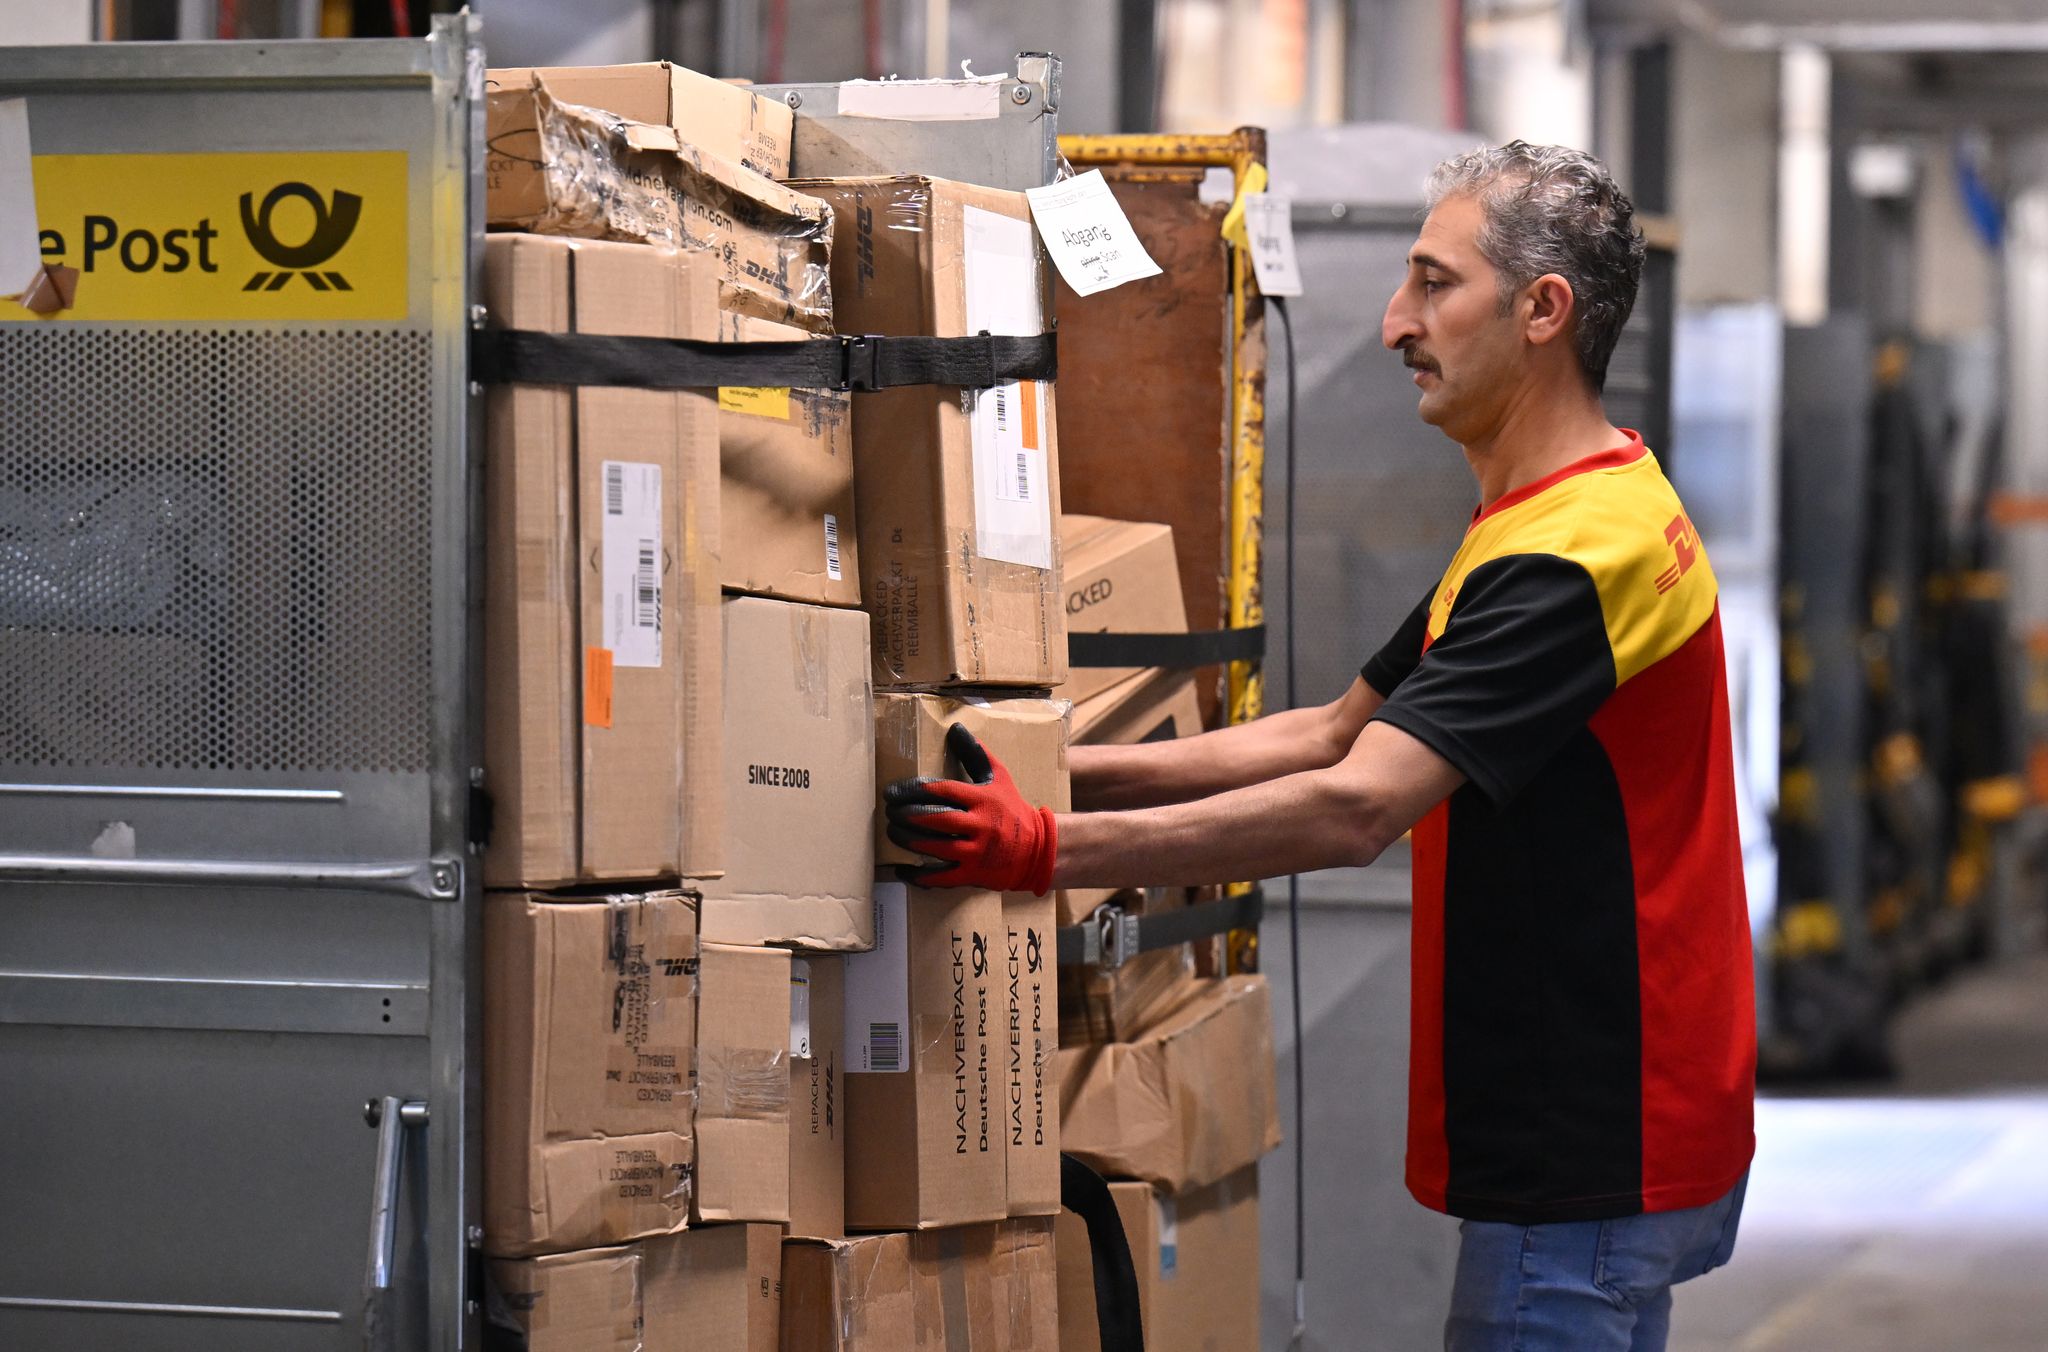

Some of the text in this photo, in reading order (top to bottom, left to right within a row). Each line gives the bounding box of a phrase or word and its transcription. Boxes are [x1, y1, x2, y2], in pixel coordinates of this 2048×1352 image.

[83, 215, 218, 274] Post
[856, 198, 873, 292] DHL
[1061, 223, 1112, 248] Abgang
[876, 581, 889, 654] REPACKED
[749, 764, 810, 789] SINCE 2008
[952, 929, 967, 1154] NACHVERPACKT
[977, 987, 989, 1152] Deutsche Post
[1007, 925, 1023, 1146] NACHVERPACKT
[1031, 983, 1043, 1146] Deutsche Post
[811, 1056, 819, 1134] REPACKED
[826, 1060, 834, 1131] DHL
